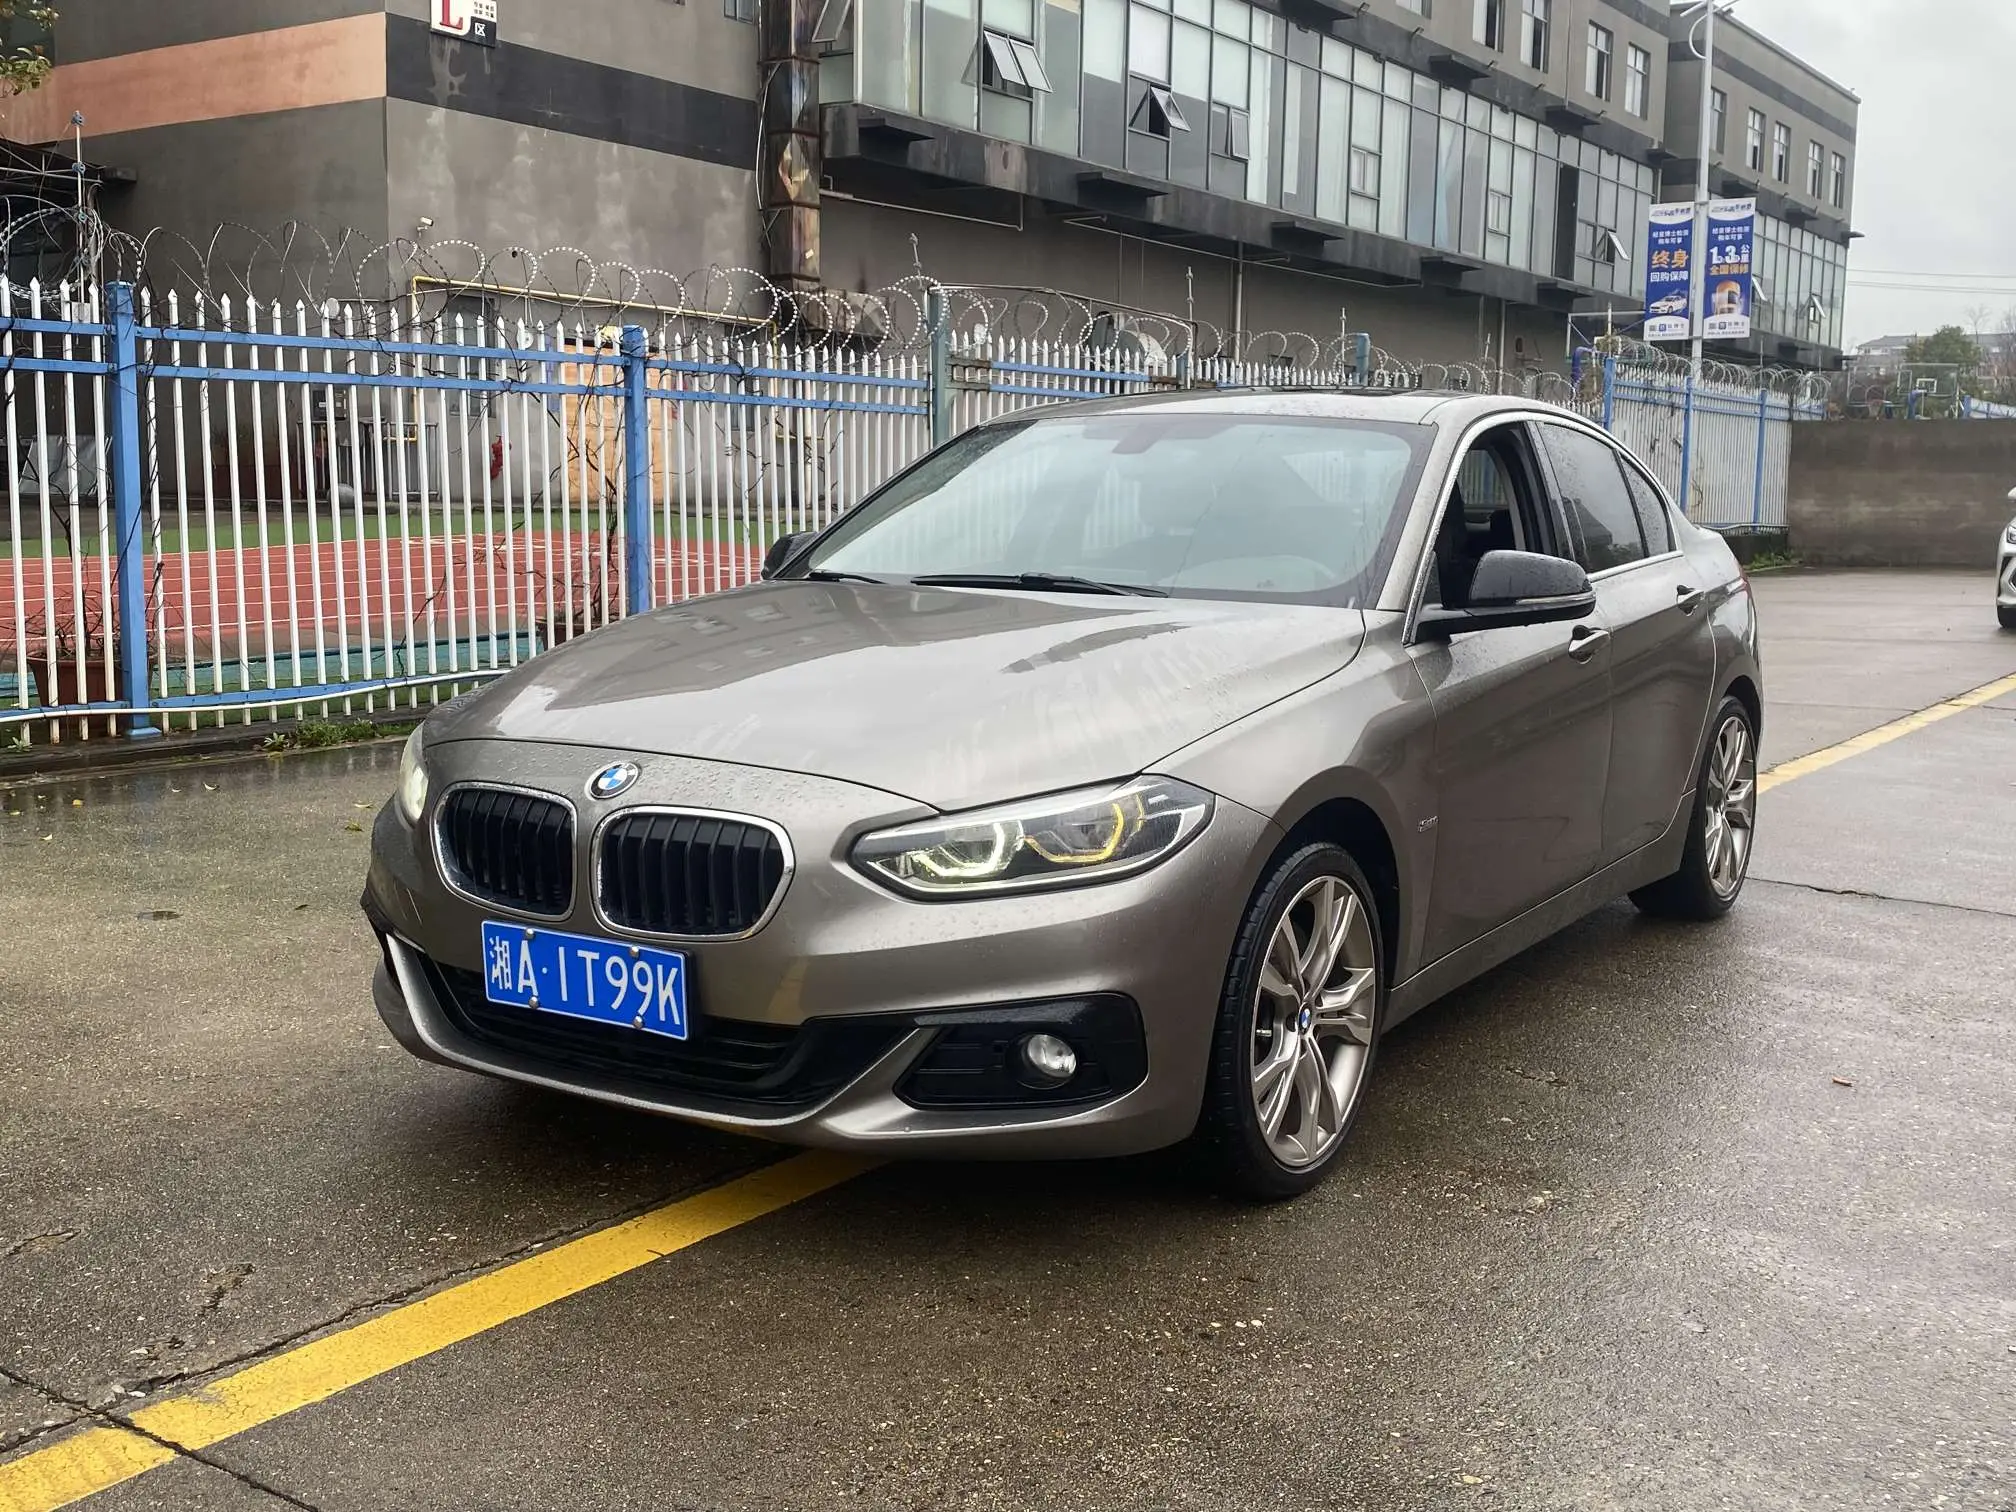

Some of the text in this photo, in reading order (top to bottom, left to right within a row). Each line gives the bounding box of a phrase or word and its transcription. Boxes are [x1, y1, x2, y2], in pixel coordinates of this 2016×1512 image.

[474, 22, 486, 36] 区
[1651, 248, 1689, 269] 终身
[1650, 270, 1689, 282] 回购保障
